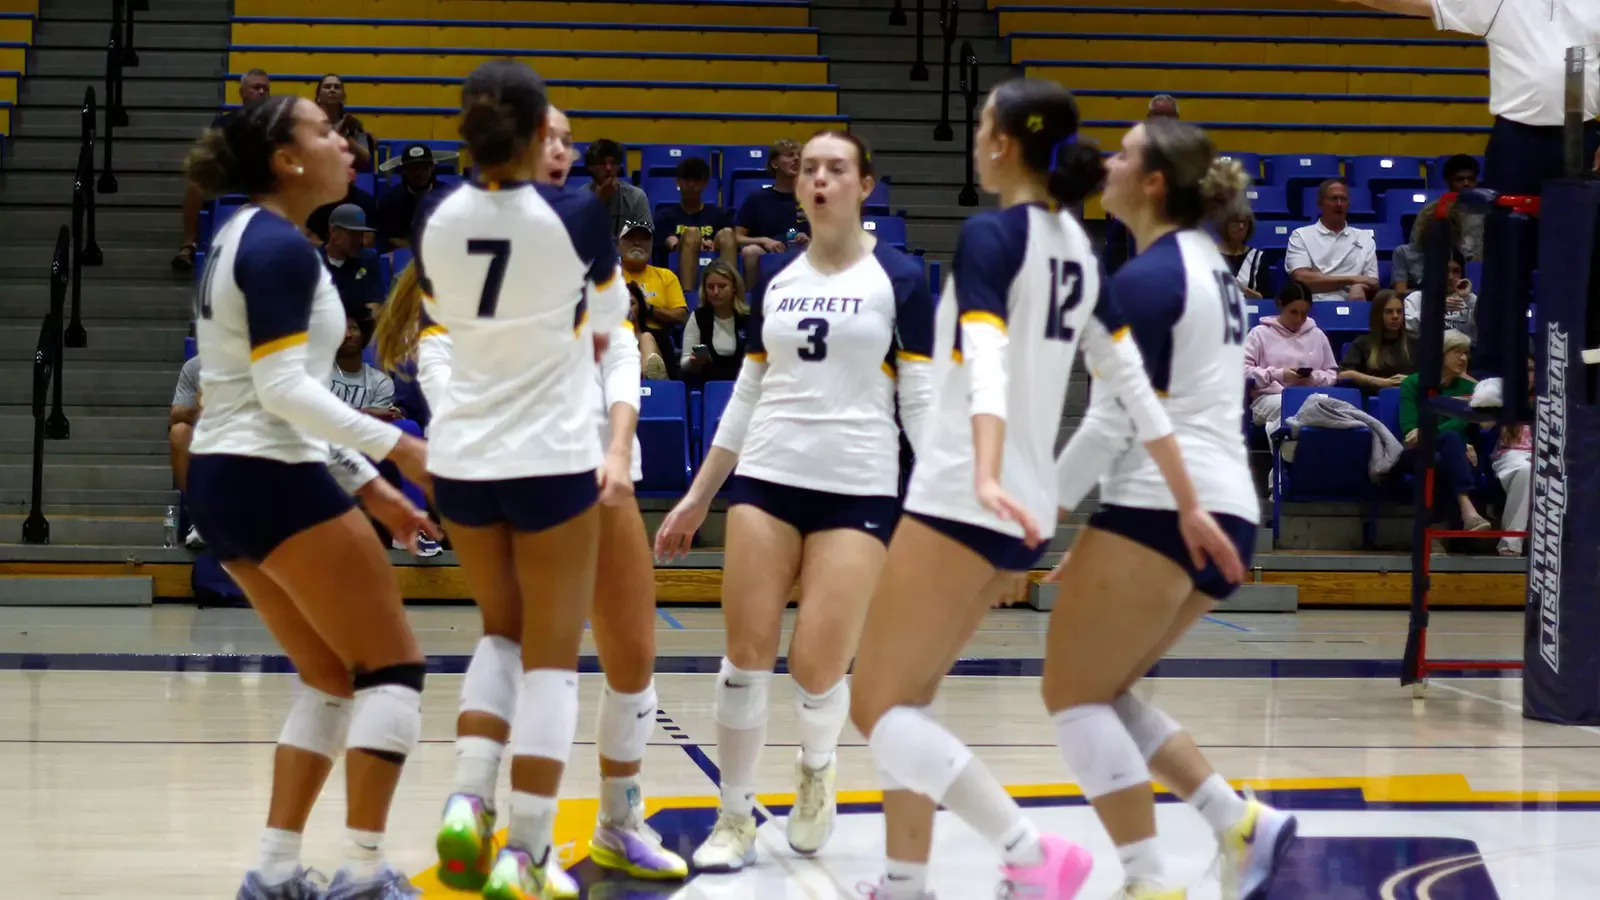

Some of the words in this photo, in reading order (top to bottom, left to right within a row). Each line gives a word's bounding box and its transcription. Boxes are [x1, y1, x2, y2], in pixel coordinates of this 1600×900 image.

[467, 239, 511, 317] 7
[776, 297, 863, 314] AVERETT
[1044, 257, 1083, 341] 12
[1213, 270, 1244, 345] 19
[797, 317, 829, 362] 3
[1549, 332, 1566, 473] AVERETT
[1532, 402, 1549, 586] VOLLEYBALL
[1542, 476, 1566, 662] UNIVERSITY
